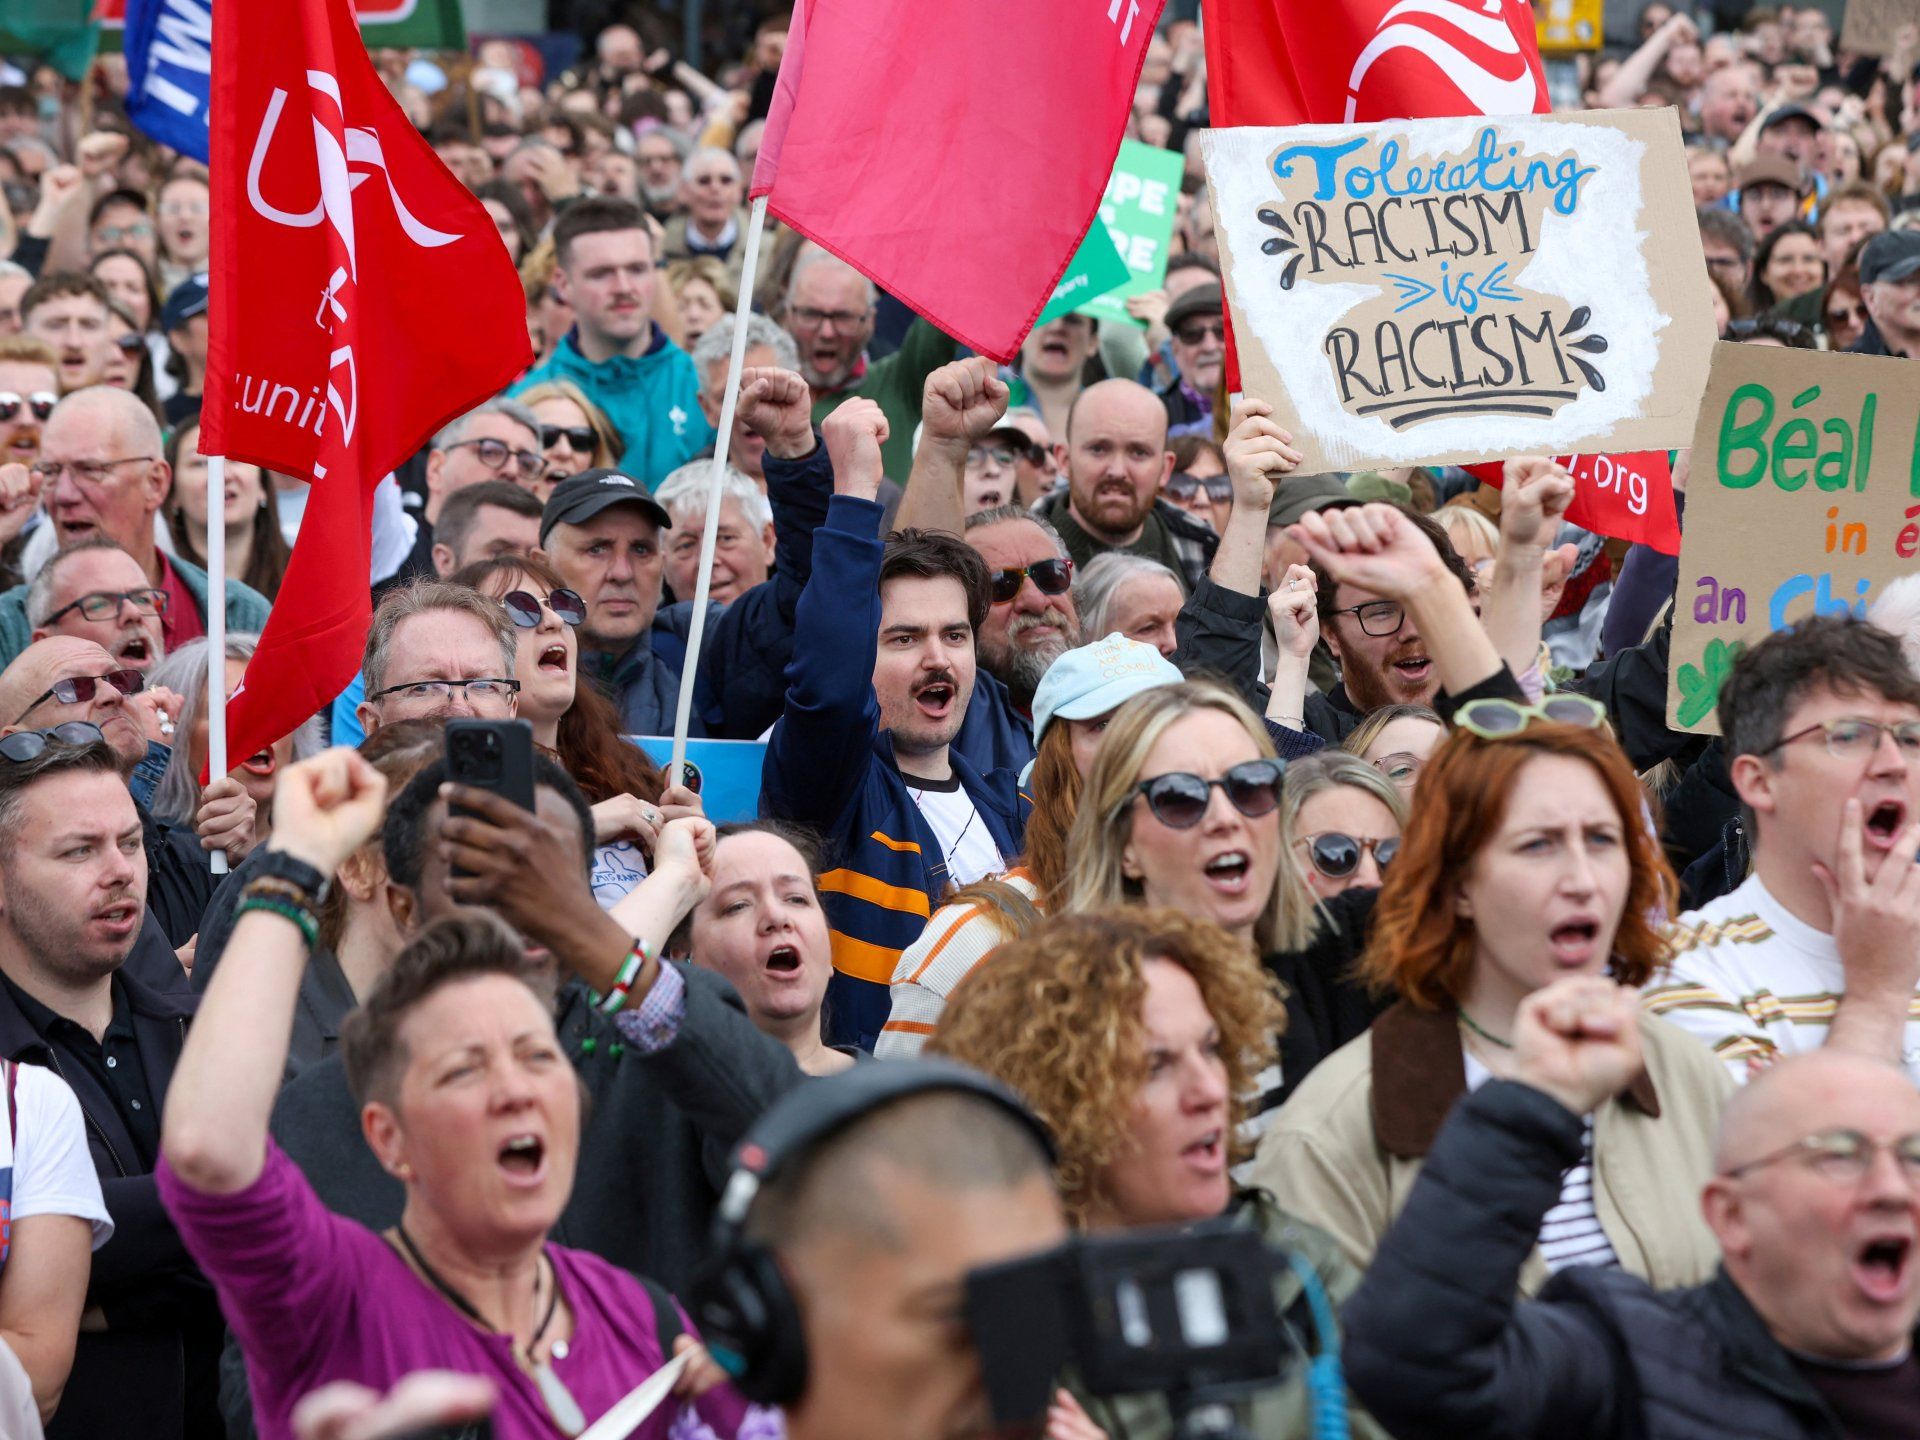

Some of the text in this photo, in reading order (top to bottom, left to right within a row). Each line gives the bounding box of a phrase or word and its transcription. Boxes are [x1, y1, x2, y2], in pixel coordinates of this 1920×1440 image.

[1102, 171, 1169, 216] PE
[1274, 127, 1597, 215] Tolerating
[1293, 190, 1535, 273] RACISM
[1440, 261, 1478, 314] is
[1326, 311, 1575, 402] RACISM
[1717, 383, 1877, 492] Béal
[1825, 506, 1867, 555] in
[1693, 576, 1746, 624] an
